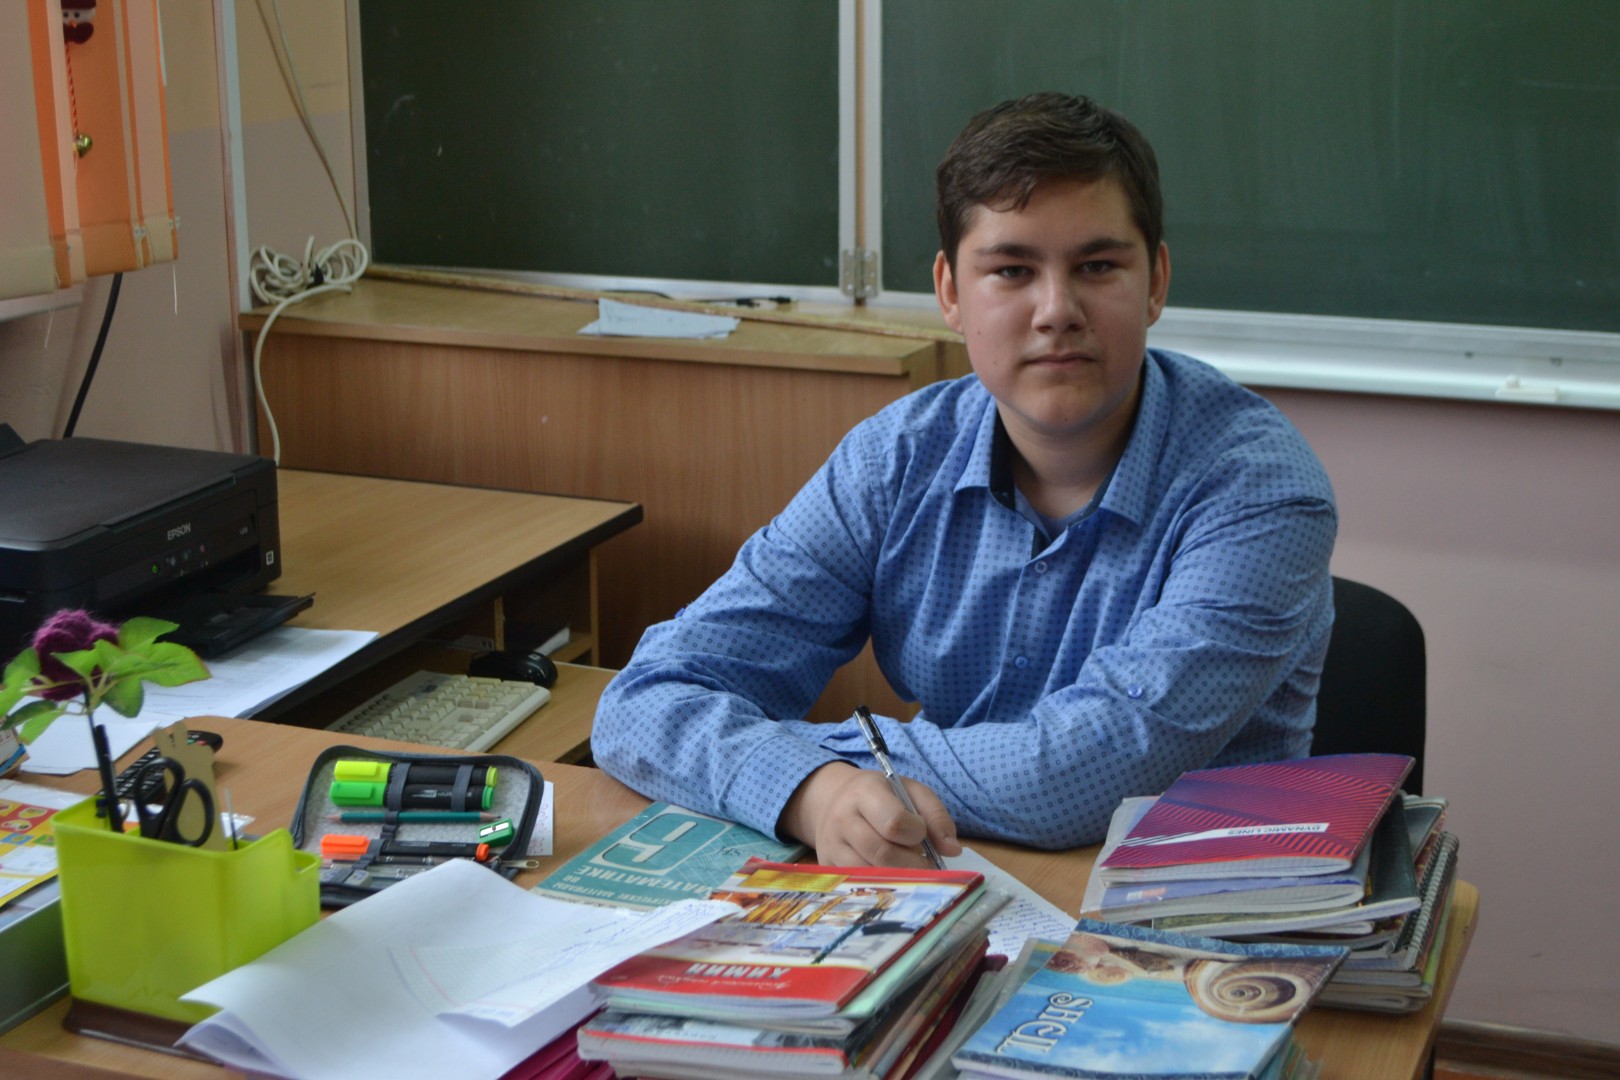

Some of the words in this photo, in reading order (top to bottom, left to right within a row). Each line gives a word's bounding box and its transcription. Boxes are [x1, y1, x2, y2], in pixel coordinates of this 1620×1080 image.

[167, 523, 191, 541] EPSON
[1227, 828, 1262, 836] LINES
[1264, 825, 1321, 833] DYNAMIC
